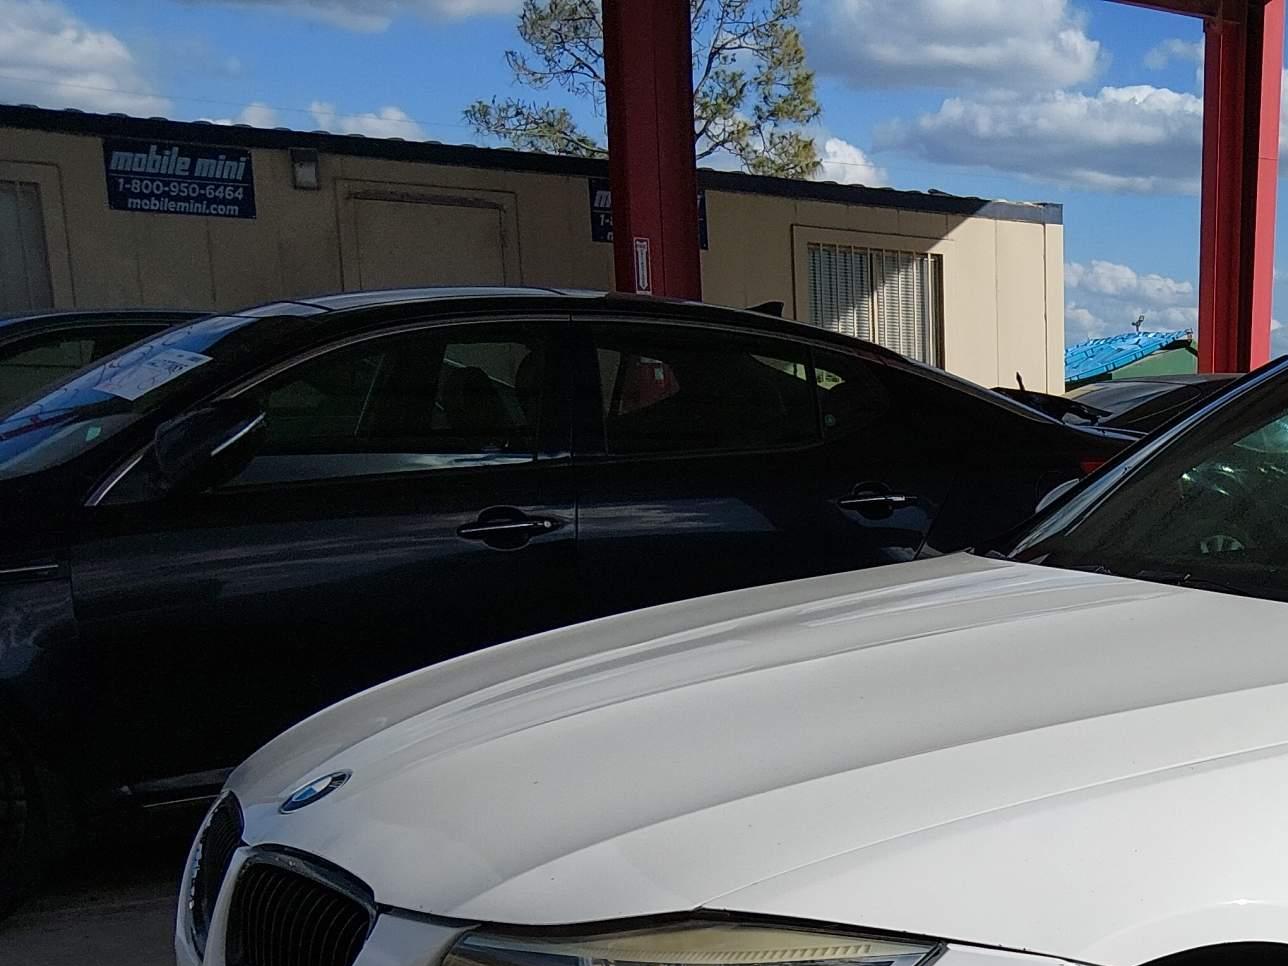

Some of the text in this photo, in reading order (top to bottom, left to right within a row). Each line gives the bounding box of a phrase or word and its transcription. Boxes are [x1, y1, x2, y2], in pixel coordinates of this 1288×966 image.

[109, 144, 247, 180] mobile mini
[117, 178, 244, 199] 1-800-950-6464
[127, 197, 239, 215] mobilemini.com
